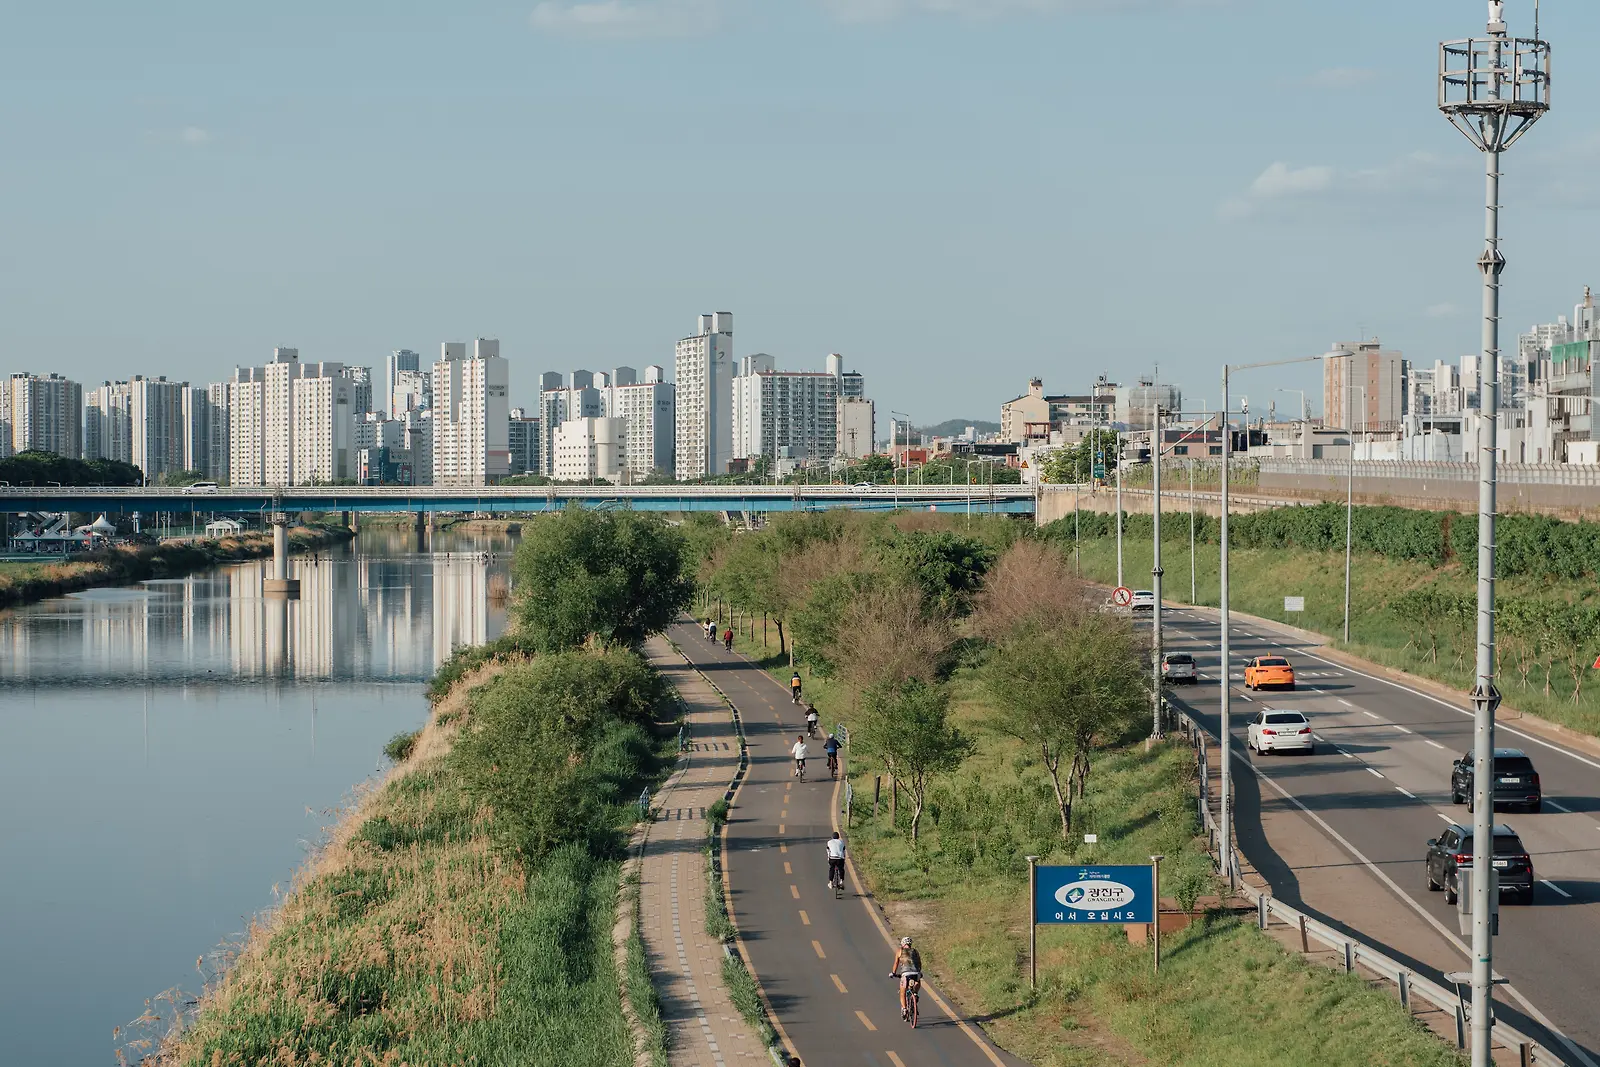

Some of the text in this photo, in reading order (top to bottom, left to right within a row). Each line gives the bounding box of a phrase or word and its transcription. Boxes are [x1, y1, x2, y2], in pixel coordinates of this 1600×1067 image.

[1088, 888, 1124, 897] 광진구
[1055, 912, 1134, 920] 어서 오십시오
